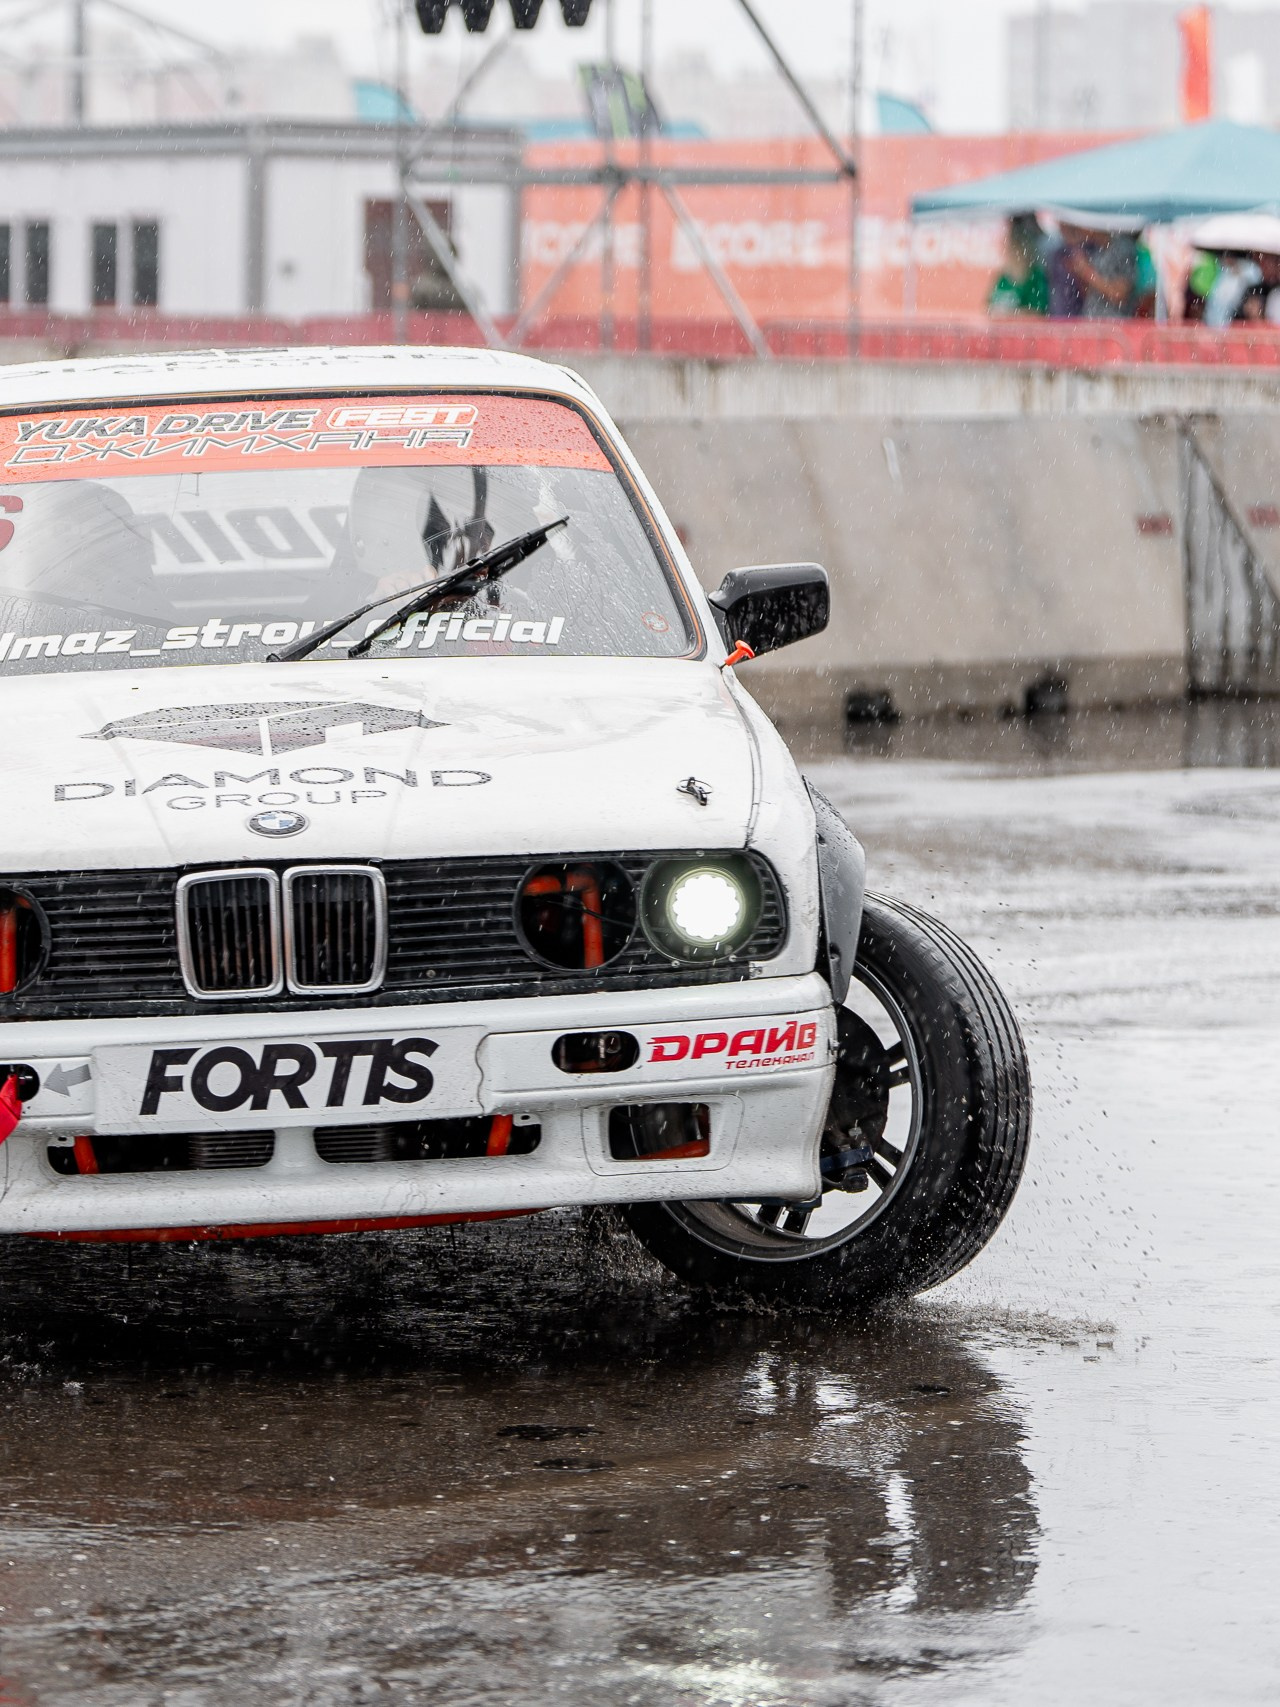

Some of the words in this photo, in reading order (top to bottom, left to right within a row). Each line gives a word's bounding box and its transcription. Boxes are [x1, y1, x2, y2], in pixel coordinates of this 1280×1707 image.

[17, 415, 147, 443] YUKA
[153, 408, 321, 435] DRIVE
[331, 407, 474, 428] FEST
[5, 428, 472, 466] ДЖИМХАНА
[53, 766, 493, 802] DIAMOND
[166, 790, 387, 810] GROUP
[646, 1021, 817, 1063] ДРАЙВ
[139, 1037, 441, 1116] FORTIS
